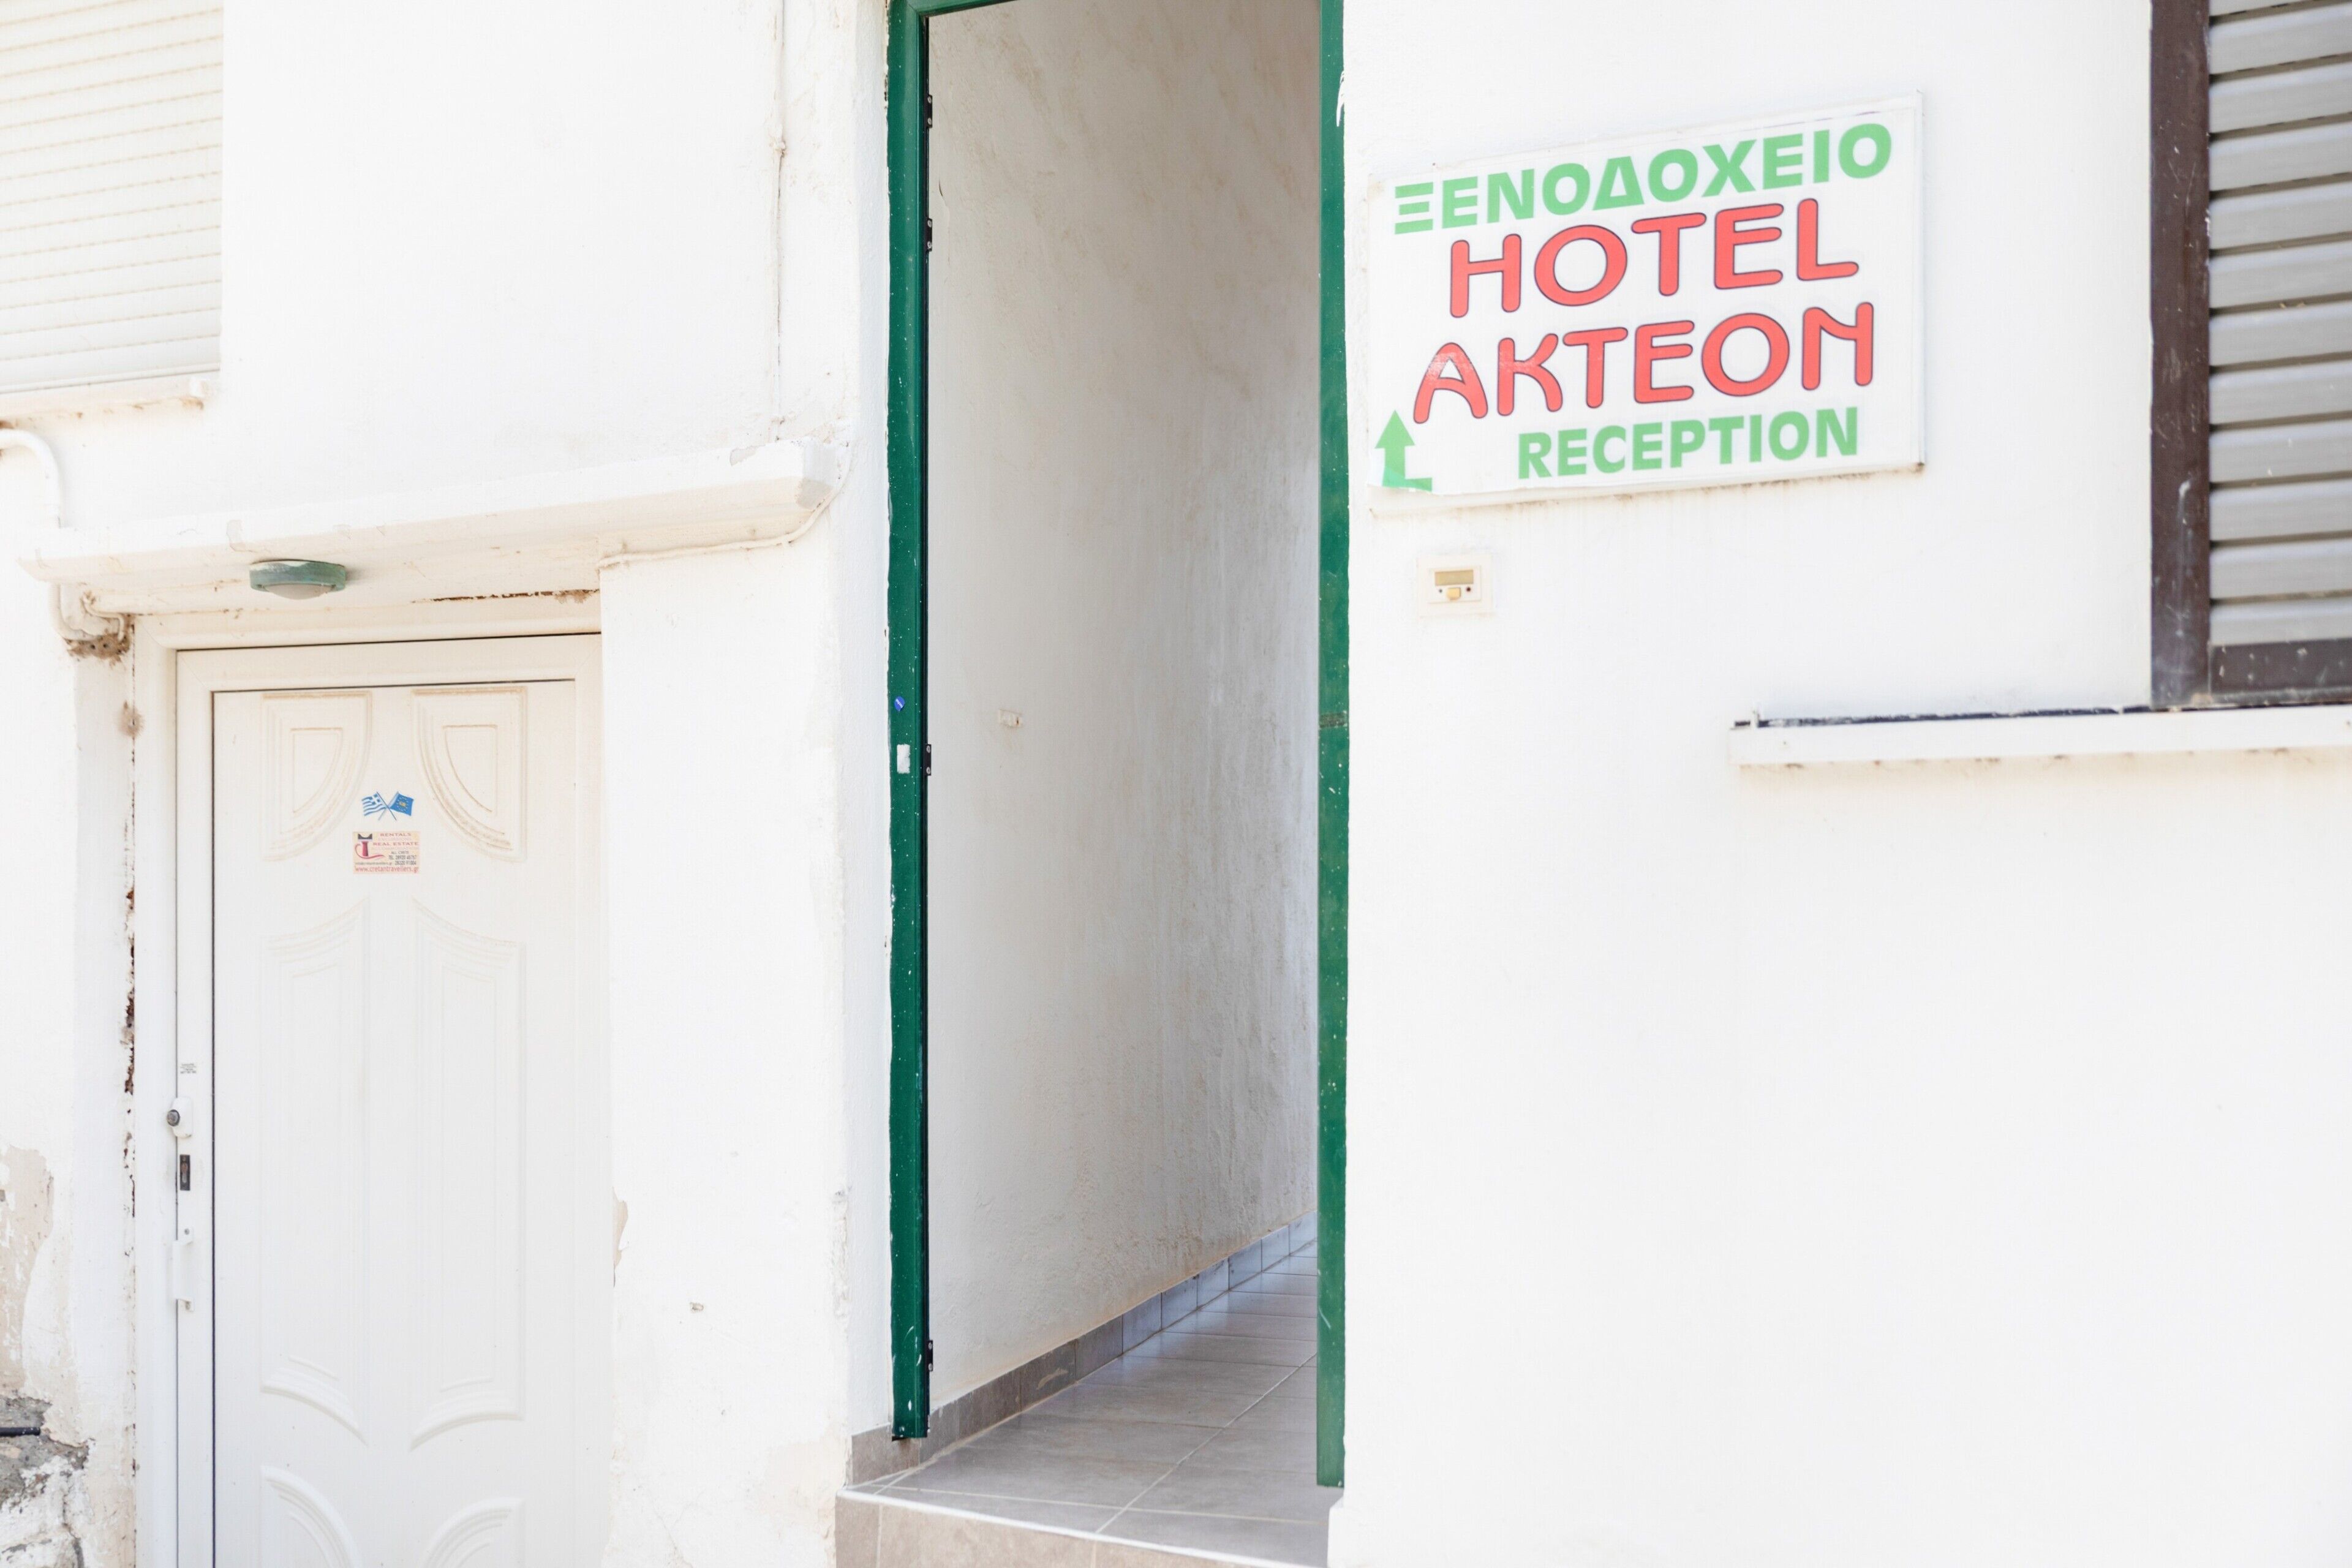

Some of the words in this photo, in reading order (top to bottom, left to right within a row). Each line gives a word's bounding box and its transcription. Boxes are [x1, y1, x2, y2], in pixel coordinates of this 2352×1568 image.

[1394, 123, 1892, 235] ΞΕΝΟΔΟΧΕΙΟ
[1449, 198, 1860, 318] HOTEL
[1412, 301, 1874, 424] AKTEON
[1518, 407, 1857, 479] RECEPTION
